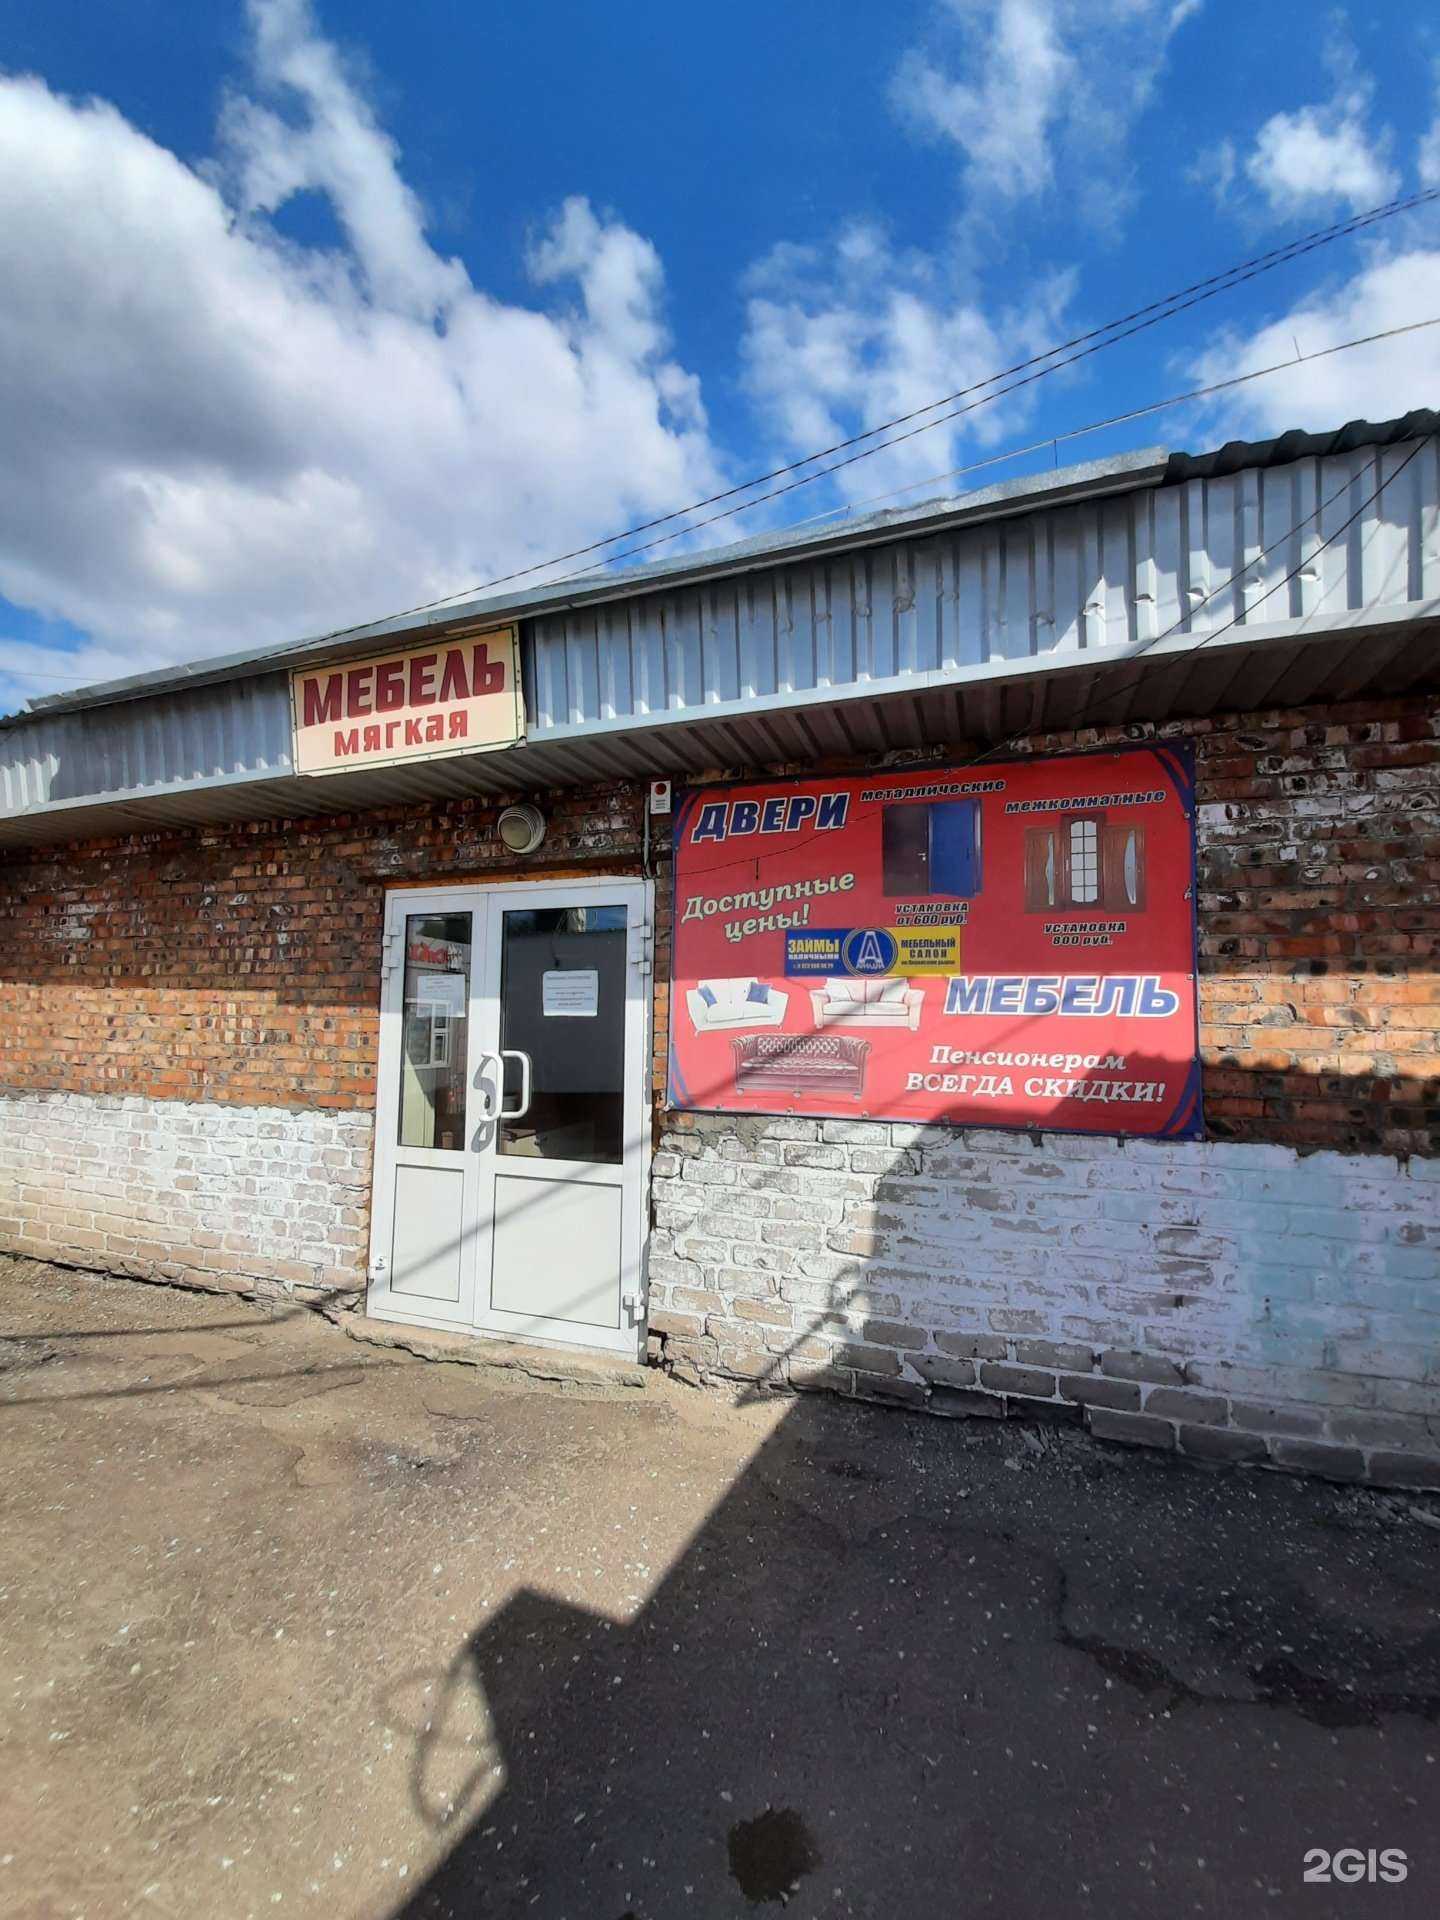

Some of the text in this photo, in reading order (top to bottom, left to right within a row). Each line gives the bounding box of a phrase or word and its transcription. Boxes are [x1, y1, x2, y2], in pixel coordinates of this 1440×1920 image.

[303, 643, 504, 727] МЕБЕЛЬ
[1005, 790, 1166, 813] межкомнатные
[690, 792, 850, 843] ДВЕРИ
[681, 872, 855, 924] Доступные
[895, 902, 969, 914] УСТАНОВКА
[724, 903, 810, 942] цены!
[913, 913, 939, 925] 600
[1044, 922, 1126, 933] УСТАНОВКА
[788, 938, 840, 953] ЗАЙМЫ
[901, 937, 956, 948] МЕБЕЛЬНЫЙ
[909, 949, 948, 958] САЛОН
[943, 975, 1180, 1018] МЕБЕЛЬ
[929, 1045, 1127, 1073] Пенсионерам
[905, 1072, 1166, 1103] ВСЕГДА СКИДКИ!
